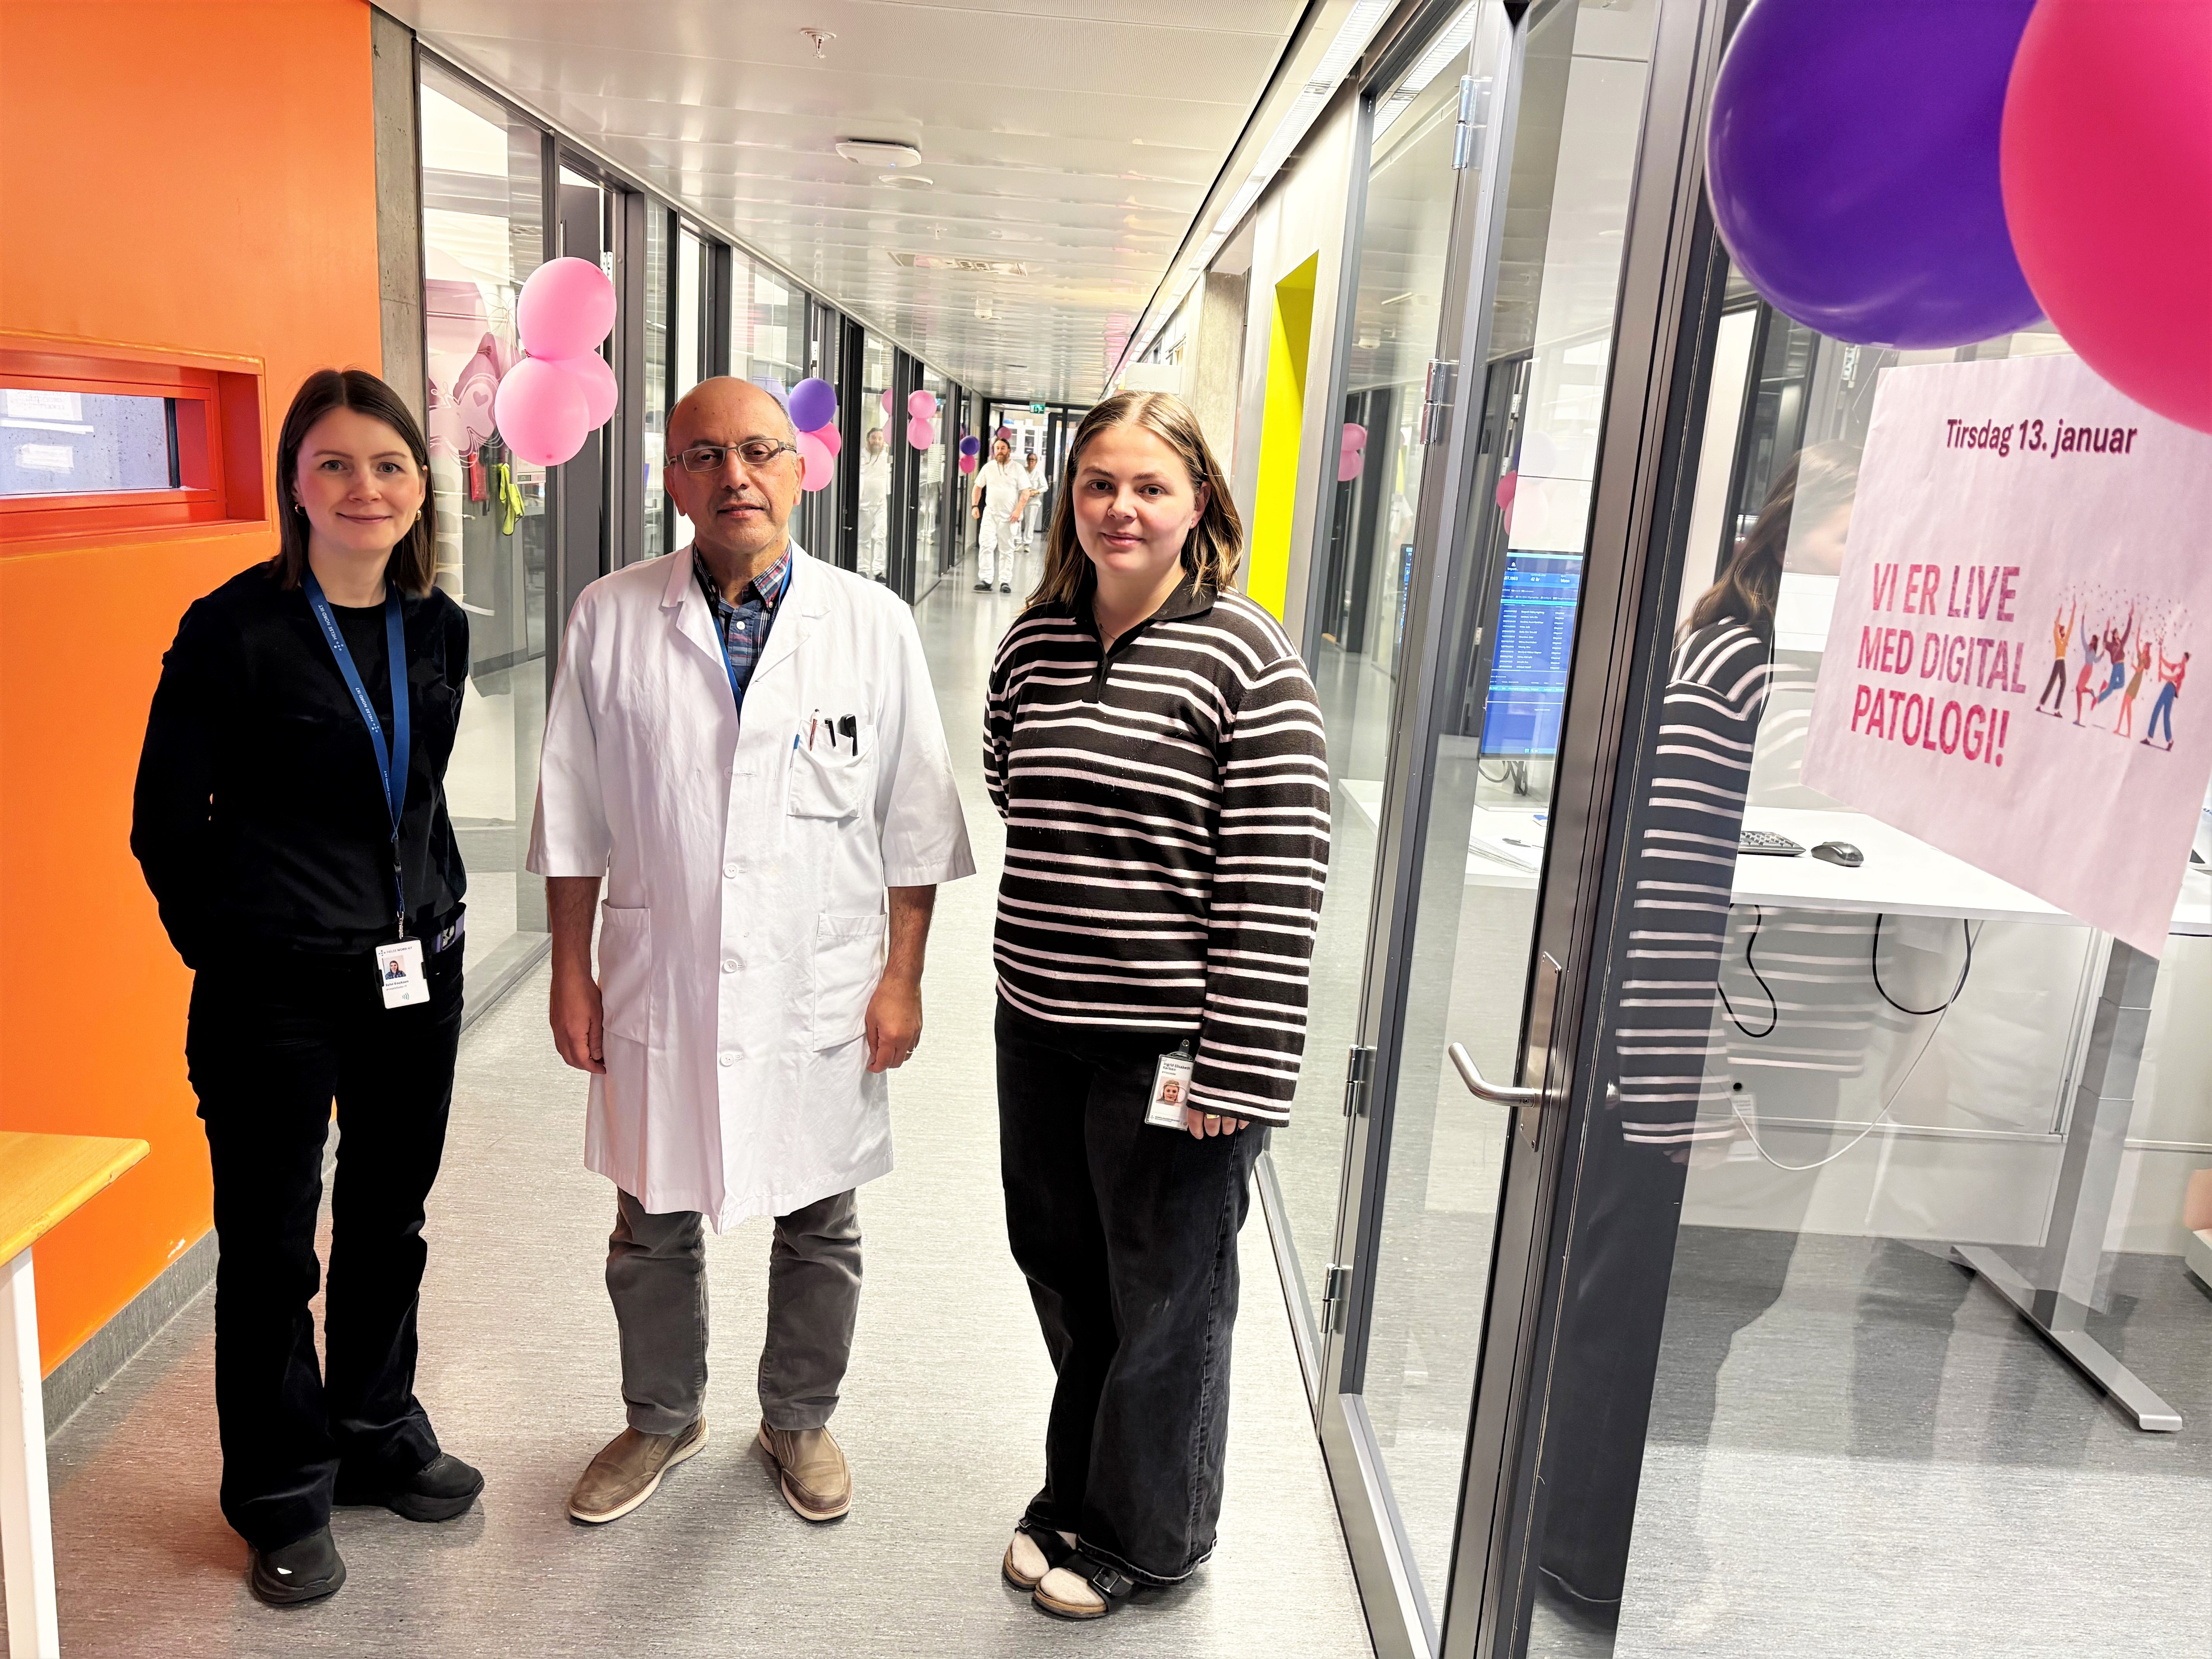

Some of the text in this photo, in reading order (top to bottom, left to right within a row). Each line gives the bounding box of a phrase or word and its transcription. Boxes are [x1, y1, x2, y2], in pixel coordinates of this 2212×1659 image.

[1947, 418, 2138, 459] Tirsdag 13. januar
[1872, 563, 2020, 622] VI ER LIVE
[322, 612, 331, 626] NORD
[328, 626, 337, 640] HELSE
[1857, 625, 2027, 694] MED DIGITAL
[359, 694, 368, 708] NORD
[365, 709, 374, 722] HELSE
[1851, 684, 2010, 768] PATOLOGI!
